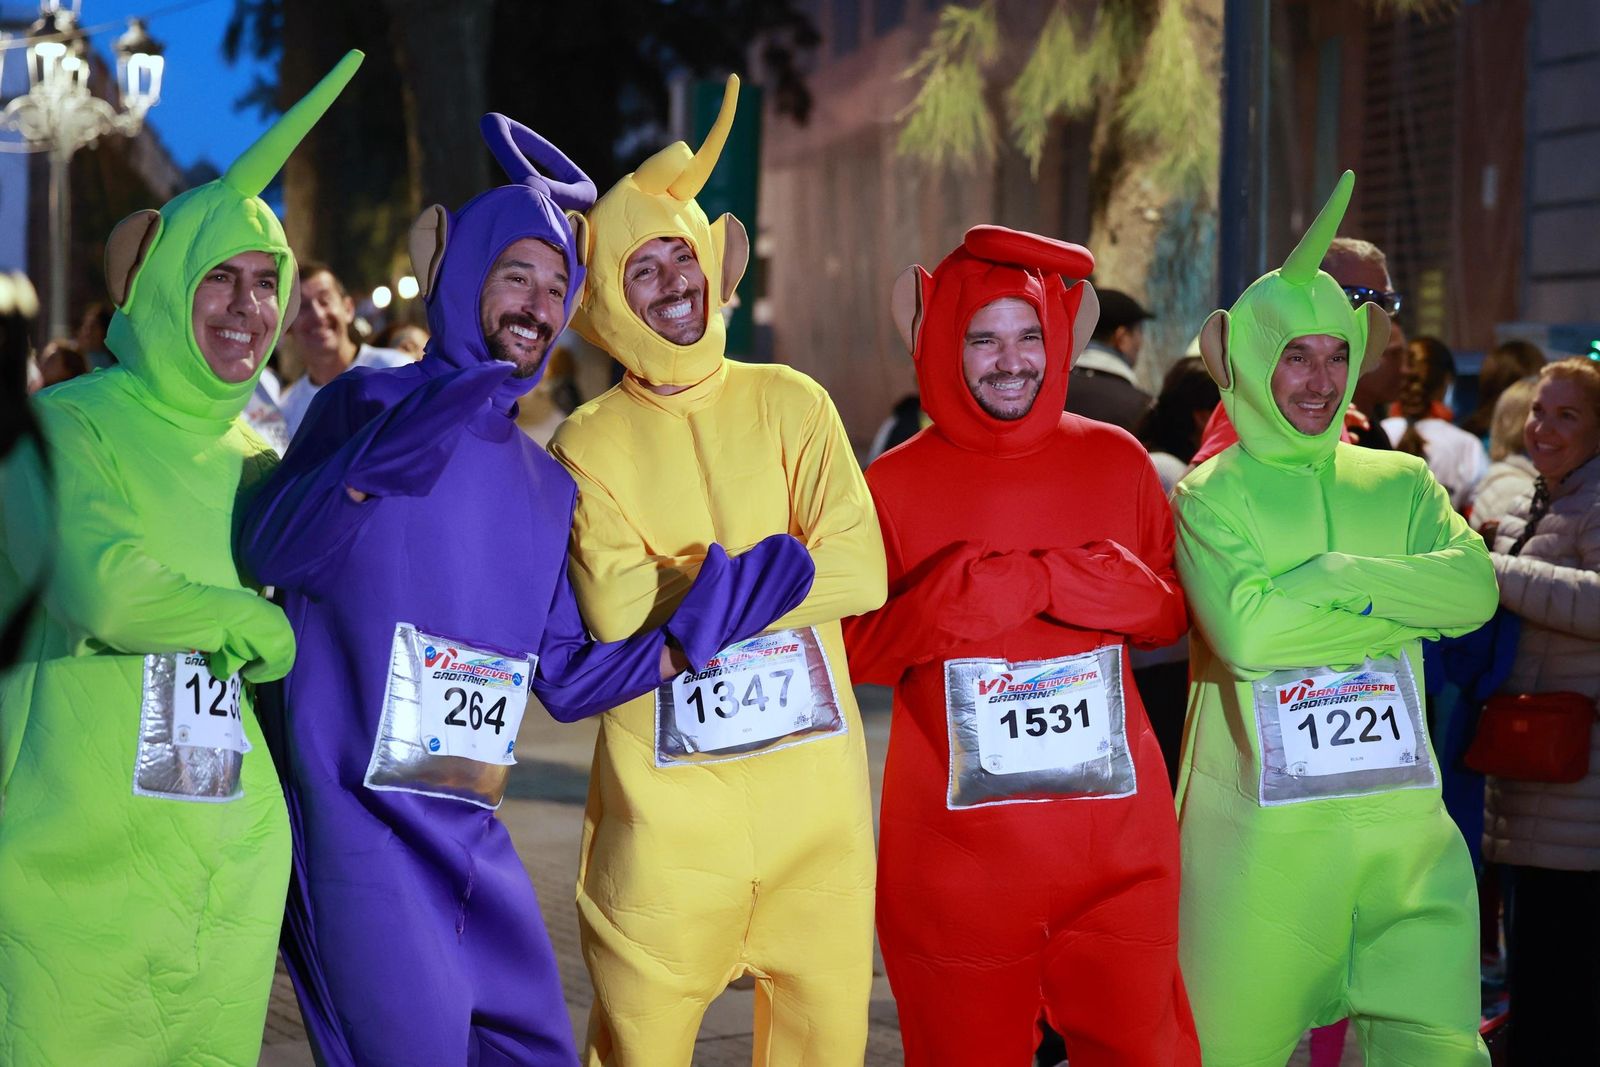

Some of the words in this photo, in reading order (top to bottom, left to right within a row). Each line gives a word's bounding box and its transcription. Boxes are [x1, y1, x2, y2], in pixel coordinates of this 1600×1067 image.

[450, 662, 474, 673] SAN
[474, 665, 525, 681] SILVEST
[704, 657, 724, 669] AN
[432, 671, 488, 686] GADITANA
[978, 673, 1013, 696] VI
[1007, 683, 1033, 692] SAN
[1037, 670, 1098, 689] SILVESTRE
[686, 668, 794, 724] 1347
[988, 689, 1057, 704] GADITANA
[1280, 679, 1315, 705] VI
[1307, 688, 1336, 699] SAN
[1338, 684, 1396, 695] SILVESTRE
[1289, 694, 1359, 712] GADITANA
[444, 687, 507, 735] 264
[1000, 698, 1090, 739] 1531
[1297, 705, 1400, 750] 1221
